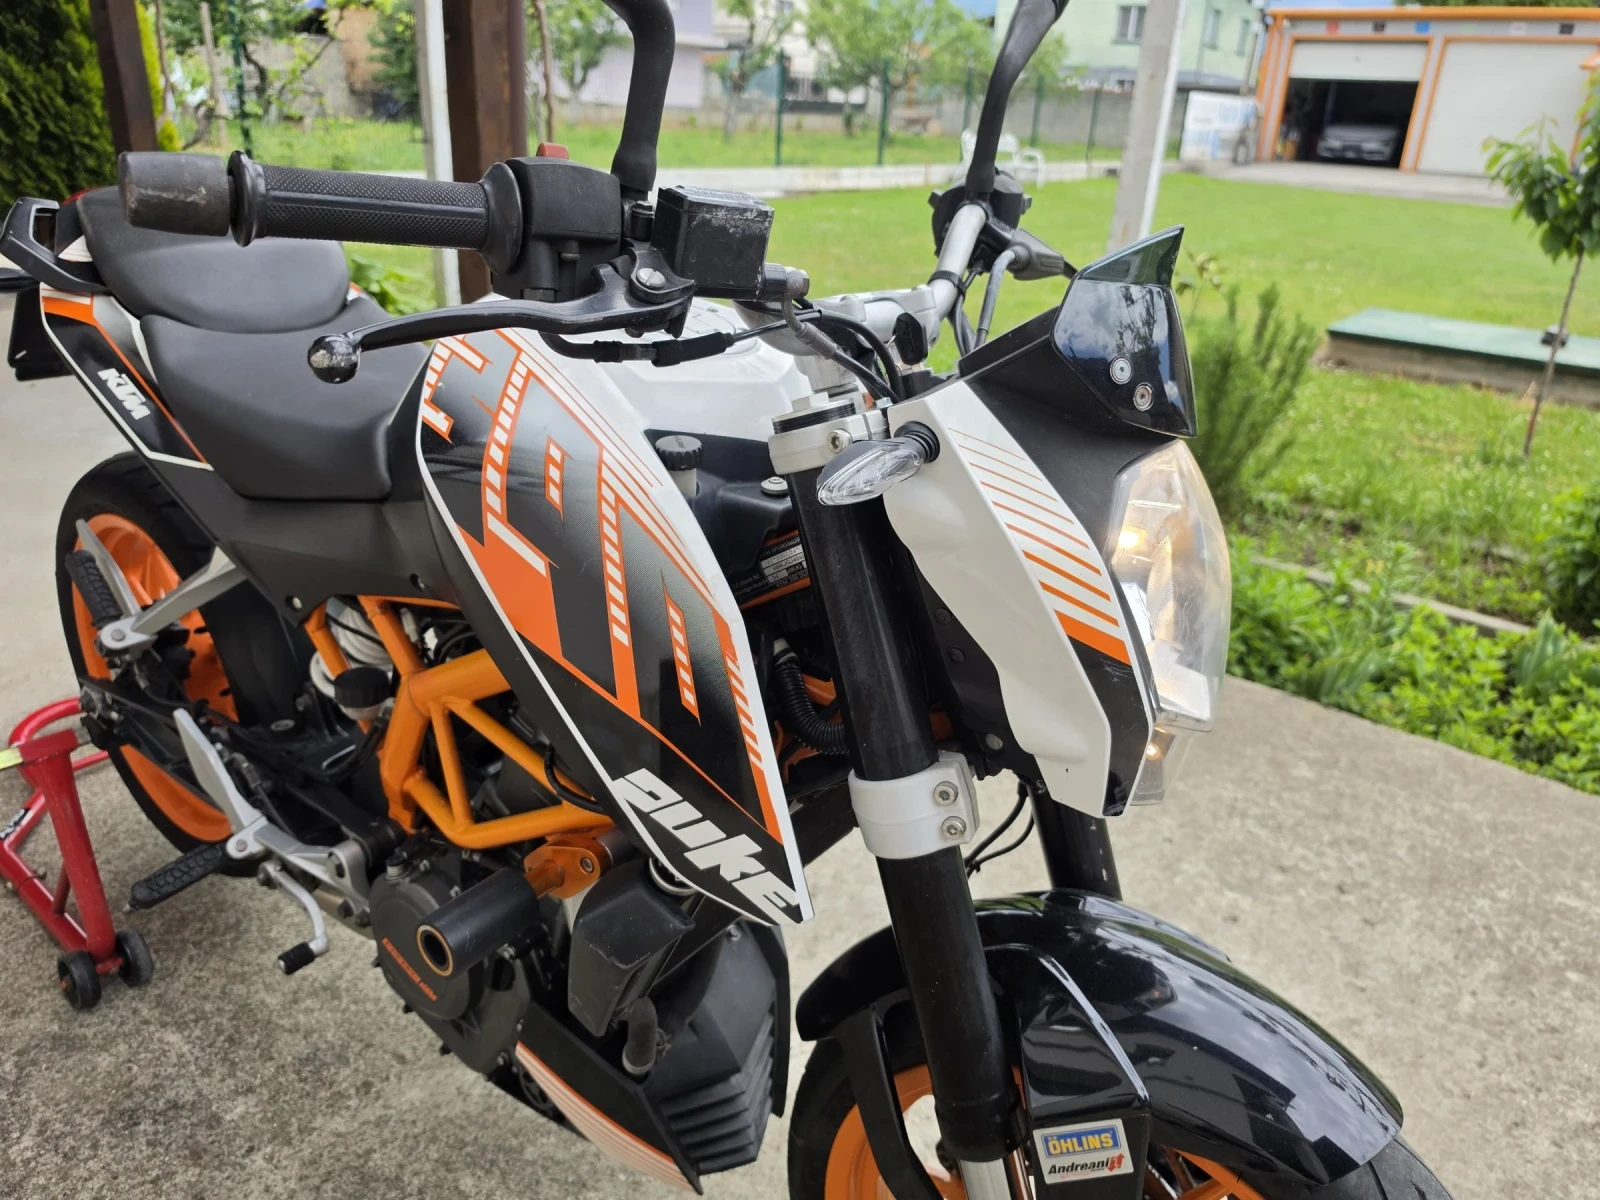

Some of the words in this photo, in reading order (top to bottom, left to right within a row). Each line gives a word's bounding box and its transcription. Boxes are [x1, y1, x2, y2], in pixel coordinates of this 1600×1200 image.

[97, 368, 151, 420] KTM
[612, 768, 800, 924] DUKE
[1048, 1133, 1114, 1155] ÖHLINS
[1048, 1157, 1110, 1174] Andreani
